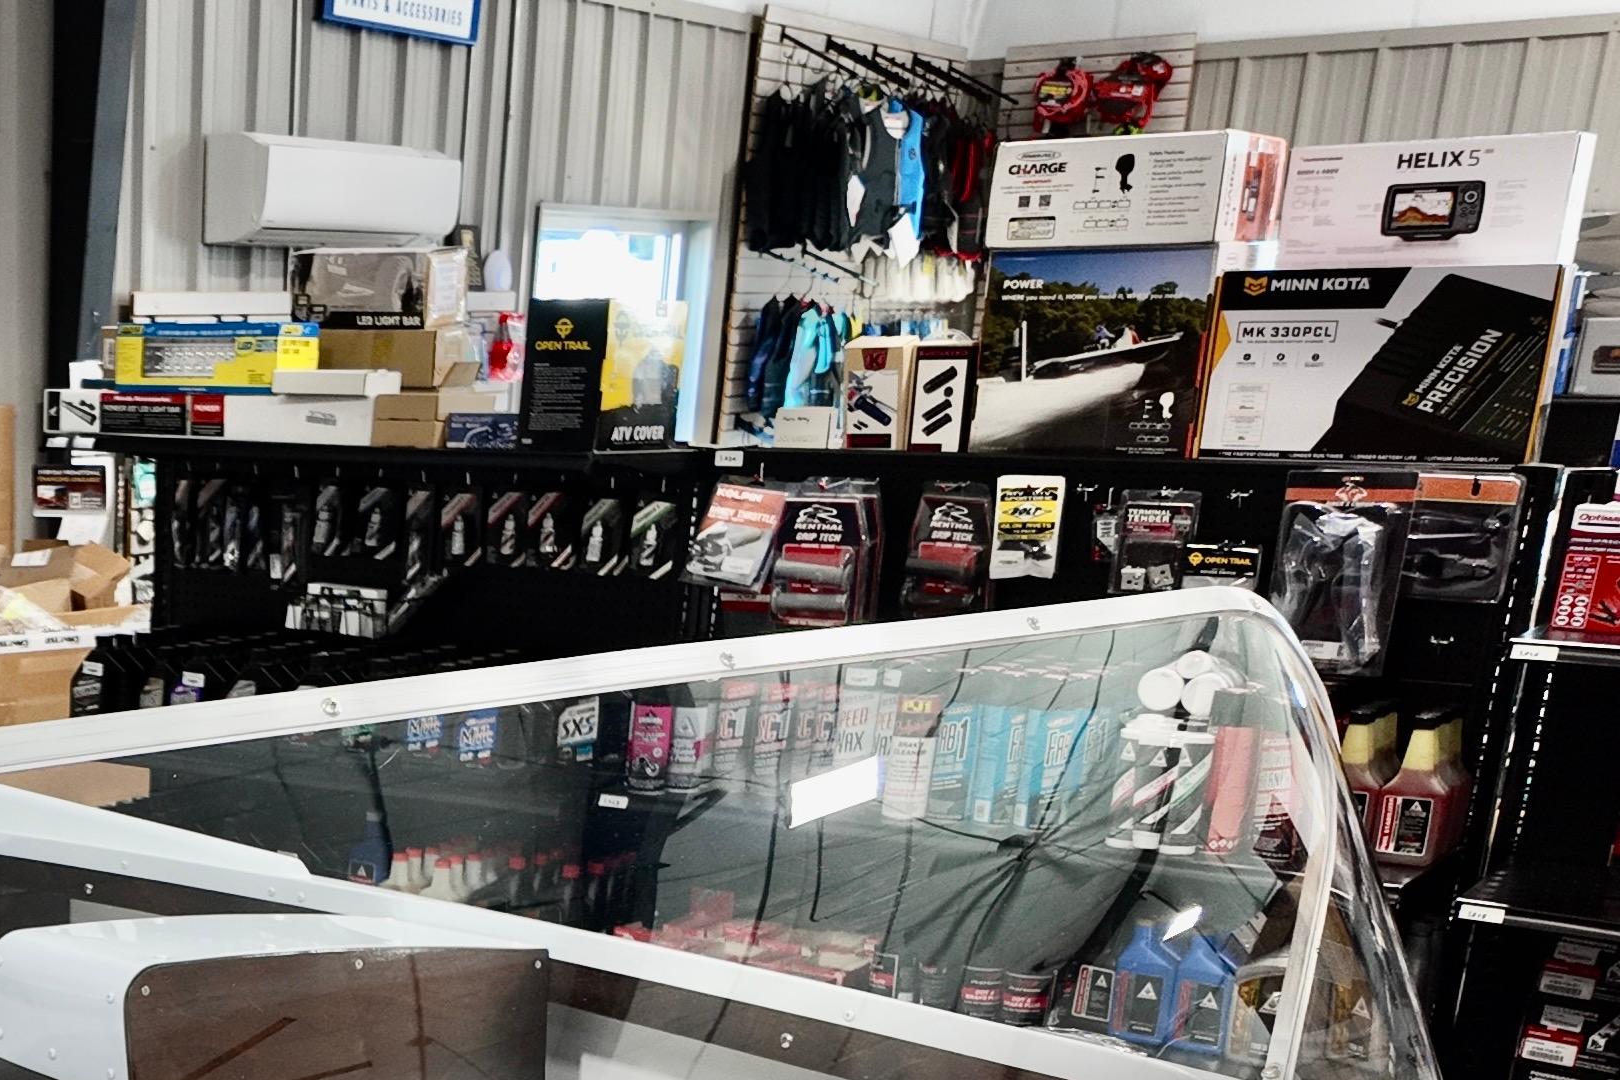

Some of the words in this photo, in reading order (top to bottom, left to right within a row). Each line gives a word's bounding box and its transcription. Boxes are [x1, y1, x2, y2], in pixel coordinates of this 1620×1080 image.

[394, 3, 463, 27] ACCESSORIES
[1396, 151, 1466, 170] HELIX
[1468, 149, 1483, 168] 5
[1008, 162, 1069, 176] CHARGE
[1002, 278, 1045, 291] POWER
[1270, 278, 1321, 292] MINN
[1321, 276, 1372, 291] KOTA
[1242, 326, 1266, 338] MK
[1270, 326, 1333, 338] 330PCL
[534, 340, 563, 351] OPEN
[563, 340, 592, 351] TRAIL
[1414, 367, 1439, 394] MINN
[1436, 344, 1464, 371] KOTA
[1416, 328, 1504, 414] PRECISION
[611, 425, 632, 442] ATV
[633, 425, 665, 441] COVER
[1010, 506, 1043, 516] BOLT
[1128, 508, 1172, 517] TERMINAL
[1128, 515, 1170, 523] TENDER
[794, 521, 844, 532] RENTHAL
[930, 521, 974, 531] RENTHAL
[818, 532, 842, 543] TECH
[952, 531, 973, 542] TECH
[1204, 556, 1229, 564] OPEN
